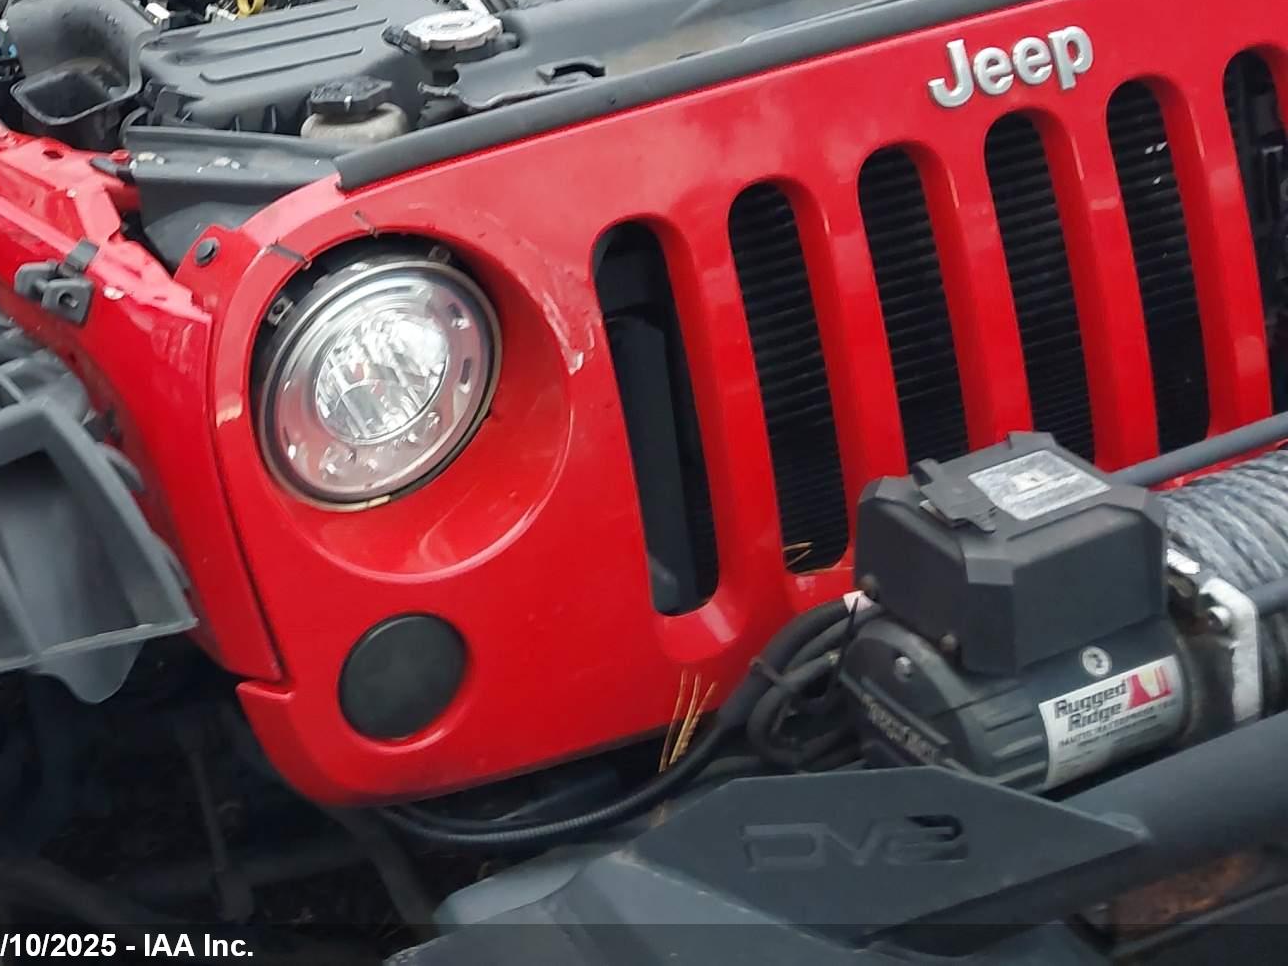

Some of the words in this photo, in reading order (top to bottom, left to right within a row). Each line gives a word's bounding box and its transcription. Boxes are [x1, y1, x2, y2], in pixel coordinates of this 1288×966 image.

[927, 25, 1094, 109] Jeep
[1053, 678, 1129, 720] Rugged
[1067, 702, 1123, 732] Ridge
